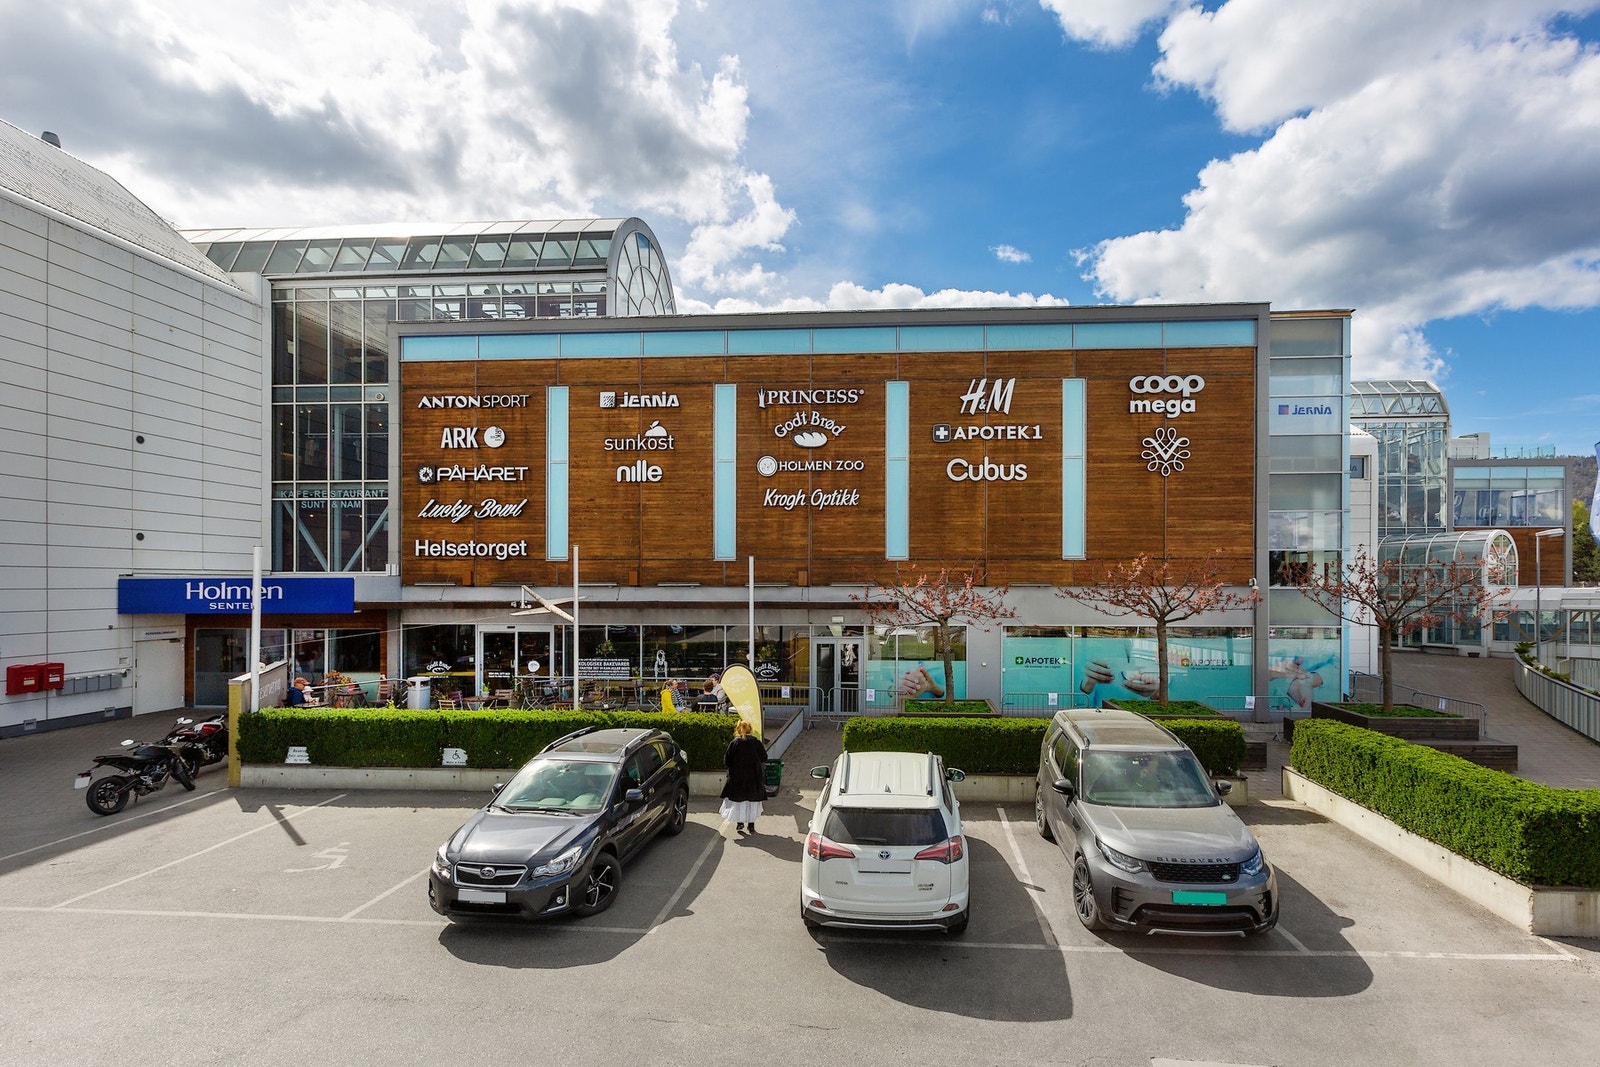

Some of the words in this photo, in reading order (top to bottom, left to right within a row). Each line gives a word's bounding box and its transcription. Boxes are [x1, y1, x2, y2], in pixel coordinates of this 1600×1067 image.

[959, 377, 1016, 415] H&M
[1129, 374, 1206, 398] coop
[1129, 398, 1196, 419] mega
[774, 411, 808, 438] Godt
[811, 411, 847, 437] Brød
[953, 425, 1030, 440] APOTEK
[1031, 424, 1043, 440] 1
[440, 426, 479, 448] ARK
[603, 434, 675, 451] sunkost
[436, 464, 529, 482] PÅHÅRET
[616, 459, 663, 483] nille
[777, 460, 832, 472] HOLMEN
[836, 459, 865, 472] ZOO
[946, 456, 1028, 482] Cubus
[301, 500, 326, 509] SUNT
[763, 488, 807, 511] Krogh
[810, 488, 860, 511] Optikk
[416, 499, 473, 524] Lucky
[474, 498, 528, 520] Bowl
[415, 539, 528, 561] Helsetorget
[1025, 657, 1061, 665] APOTEK
